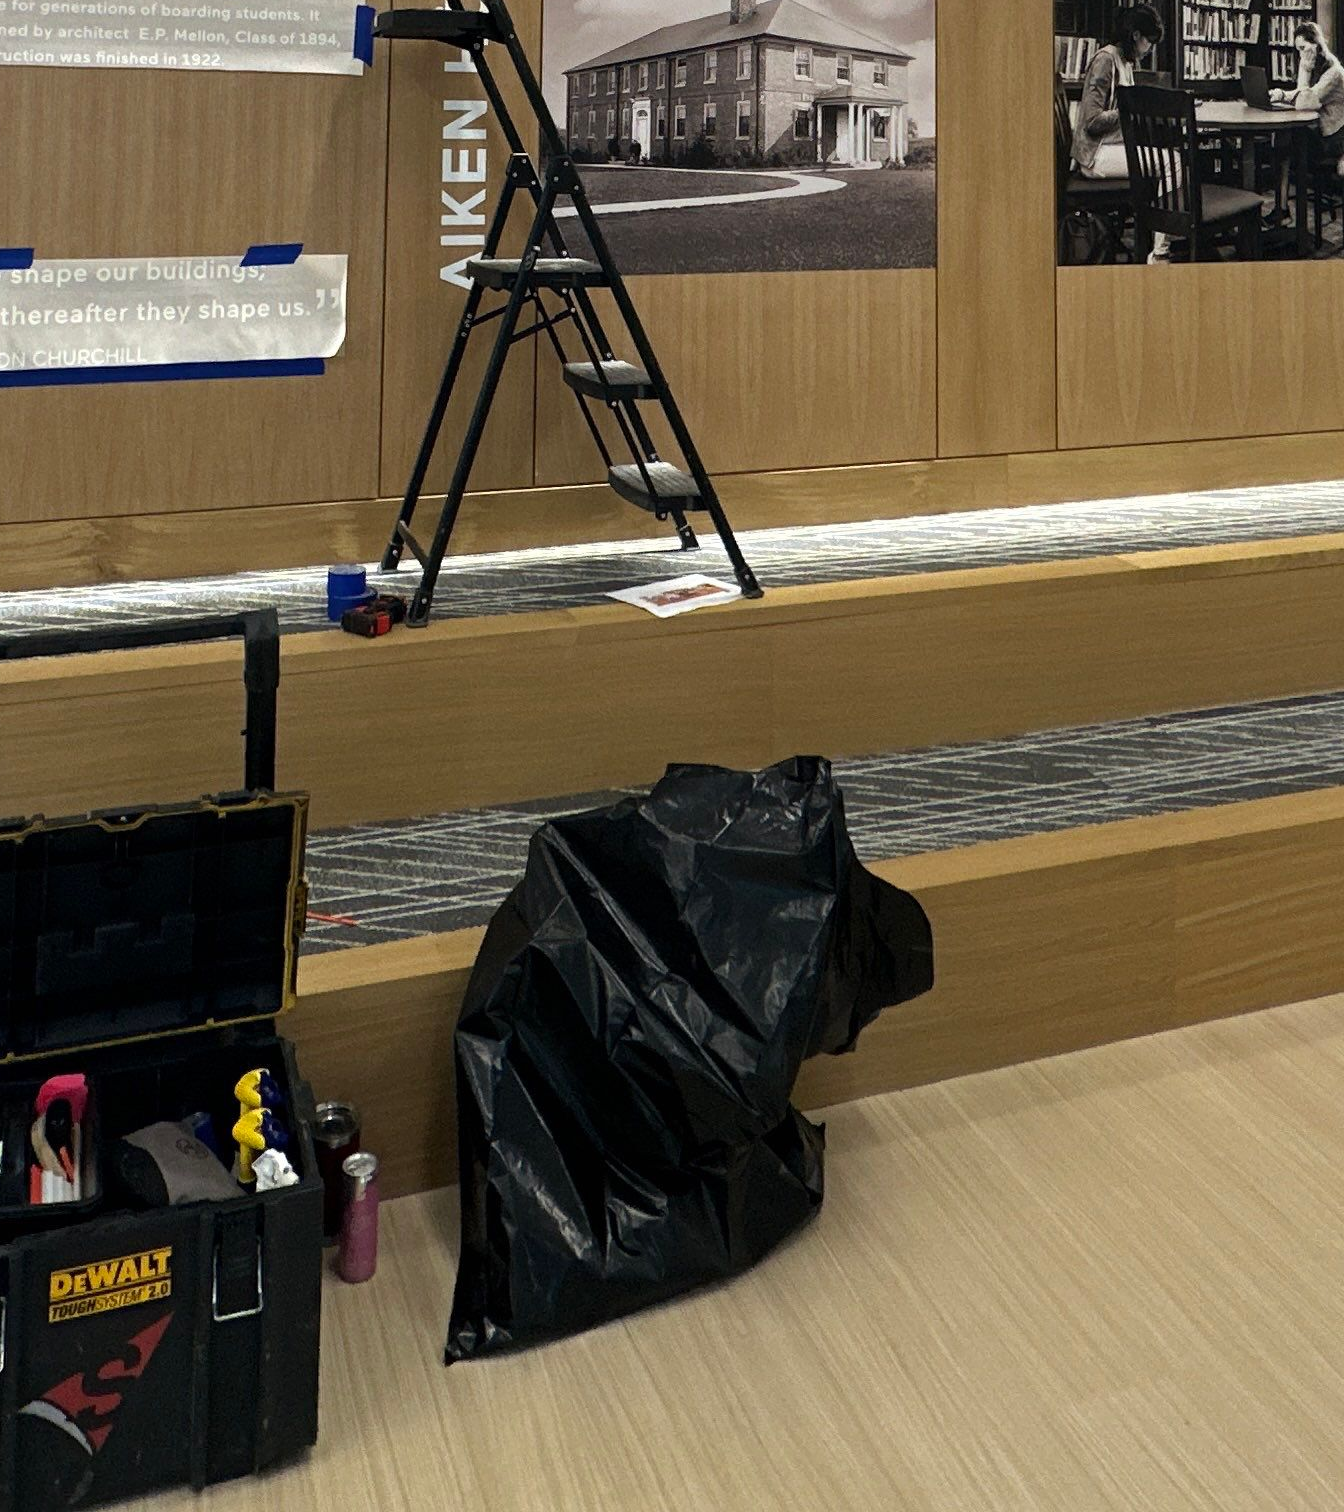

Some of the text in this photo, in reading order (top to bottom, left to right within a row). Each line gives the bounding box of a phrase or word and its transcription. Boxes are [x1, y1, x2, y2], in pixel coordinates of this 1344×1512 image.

[40, 1, 136, 16] generations
[140, 3, 157, 16] of
[161, 4, 231, 21] boarding
[235, 8, 304, 22] students.
[309, 9, 320, 21] It
[33, 24, 52, 40] by
[58, 24, 129, 40] architect
[139, 27, 168, 41] E.P.
[174, 29, 230, 45] Mellon,
[234, 30, 276, 44] Class
[279, 31, 297, 45] of
[299, 32, 341, 48] 1894,
[59, 52, 91, 64] was
[96, 50, 157, 65] finished
[163, 54, 177, 66] in
[182, 53, 225, 67] 1922.
[440, 100, 487, 290] AIKEN
[96, 266, 139, 283] our
[0, 302, 128, 326] thereafter
[136, 300, 190, 325] they
[198, 299, 270, 322] shape
[33, 346, 147, 367] CHURCHILL
[50, 1251, 172, 1300] DEWALT
[149, 1282, 170, 1299] 2.0
